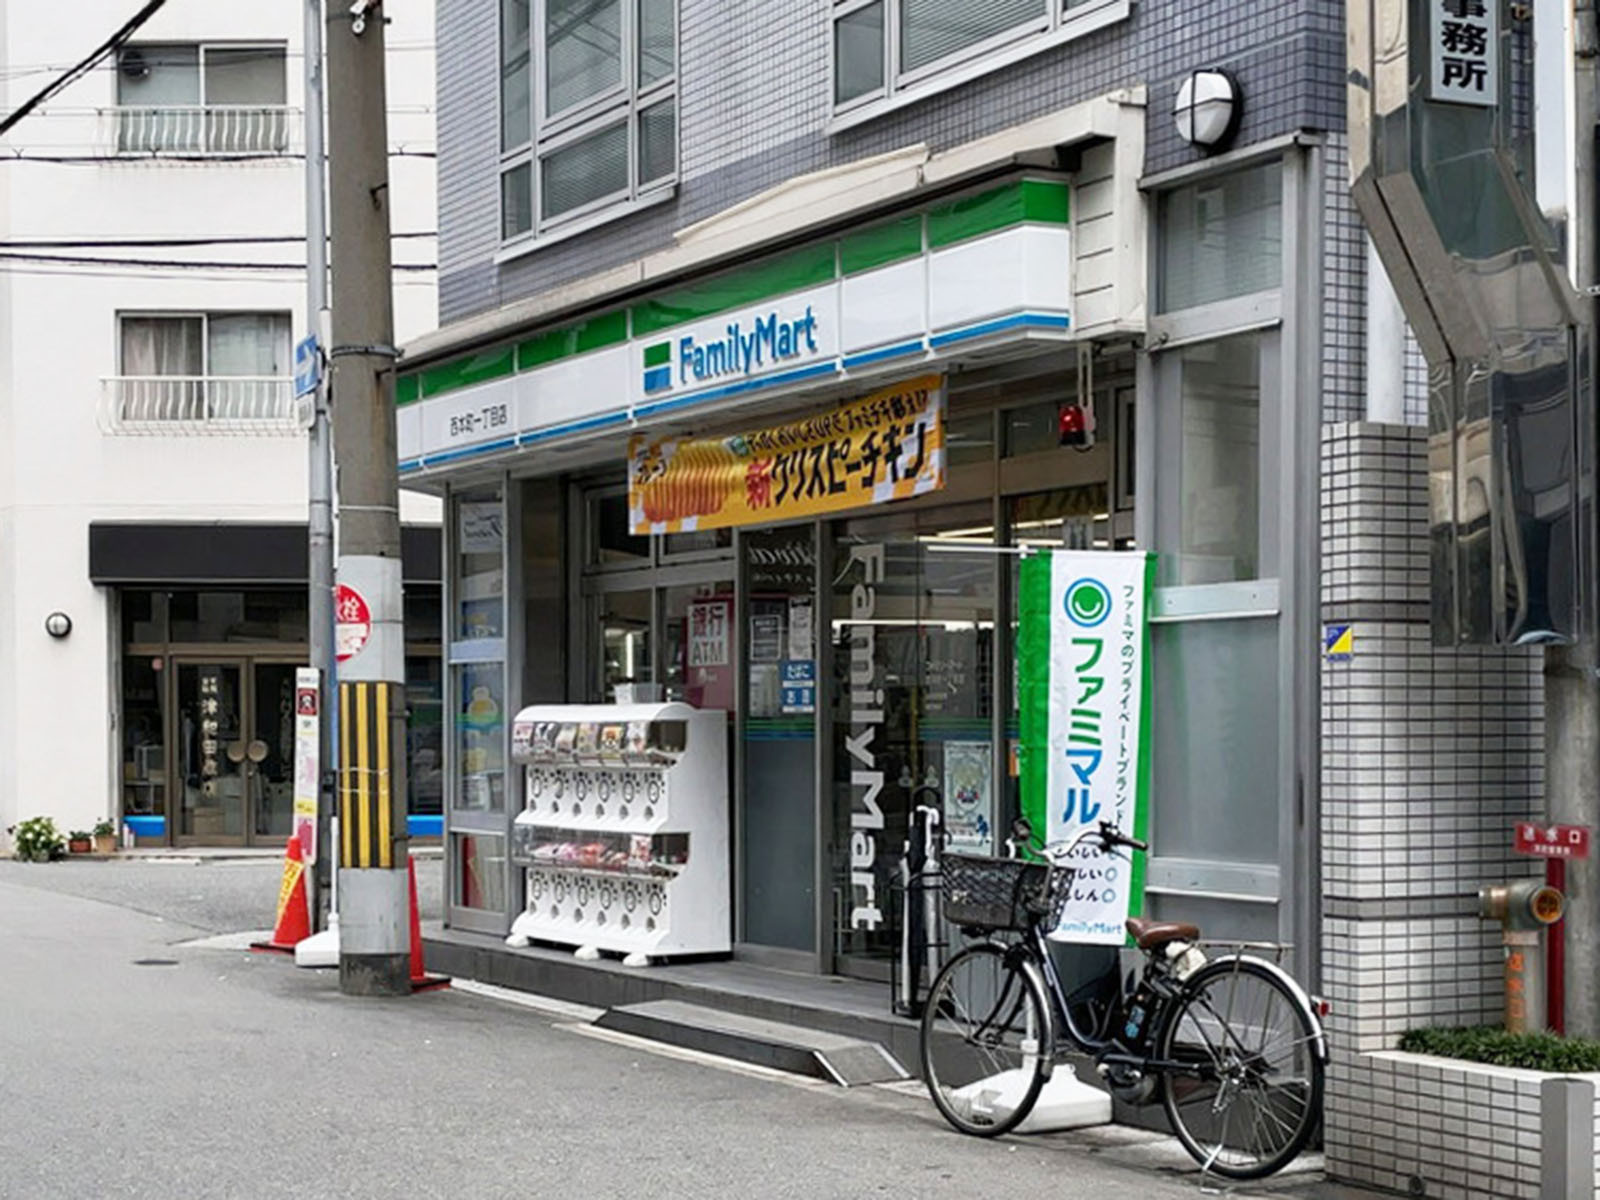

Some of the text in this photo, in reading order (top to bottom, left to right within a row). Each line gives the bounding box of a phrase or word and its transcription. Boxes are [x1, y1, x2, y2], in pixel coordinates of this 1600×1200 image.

[679, 305, 817, 384] FamilyMart
[692, 640, 724, 663] ATM
[845, 543, 885, 931] FamilyMart
[1062, 637, 1104, 824] ファミマル
